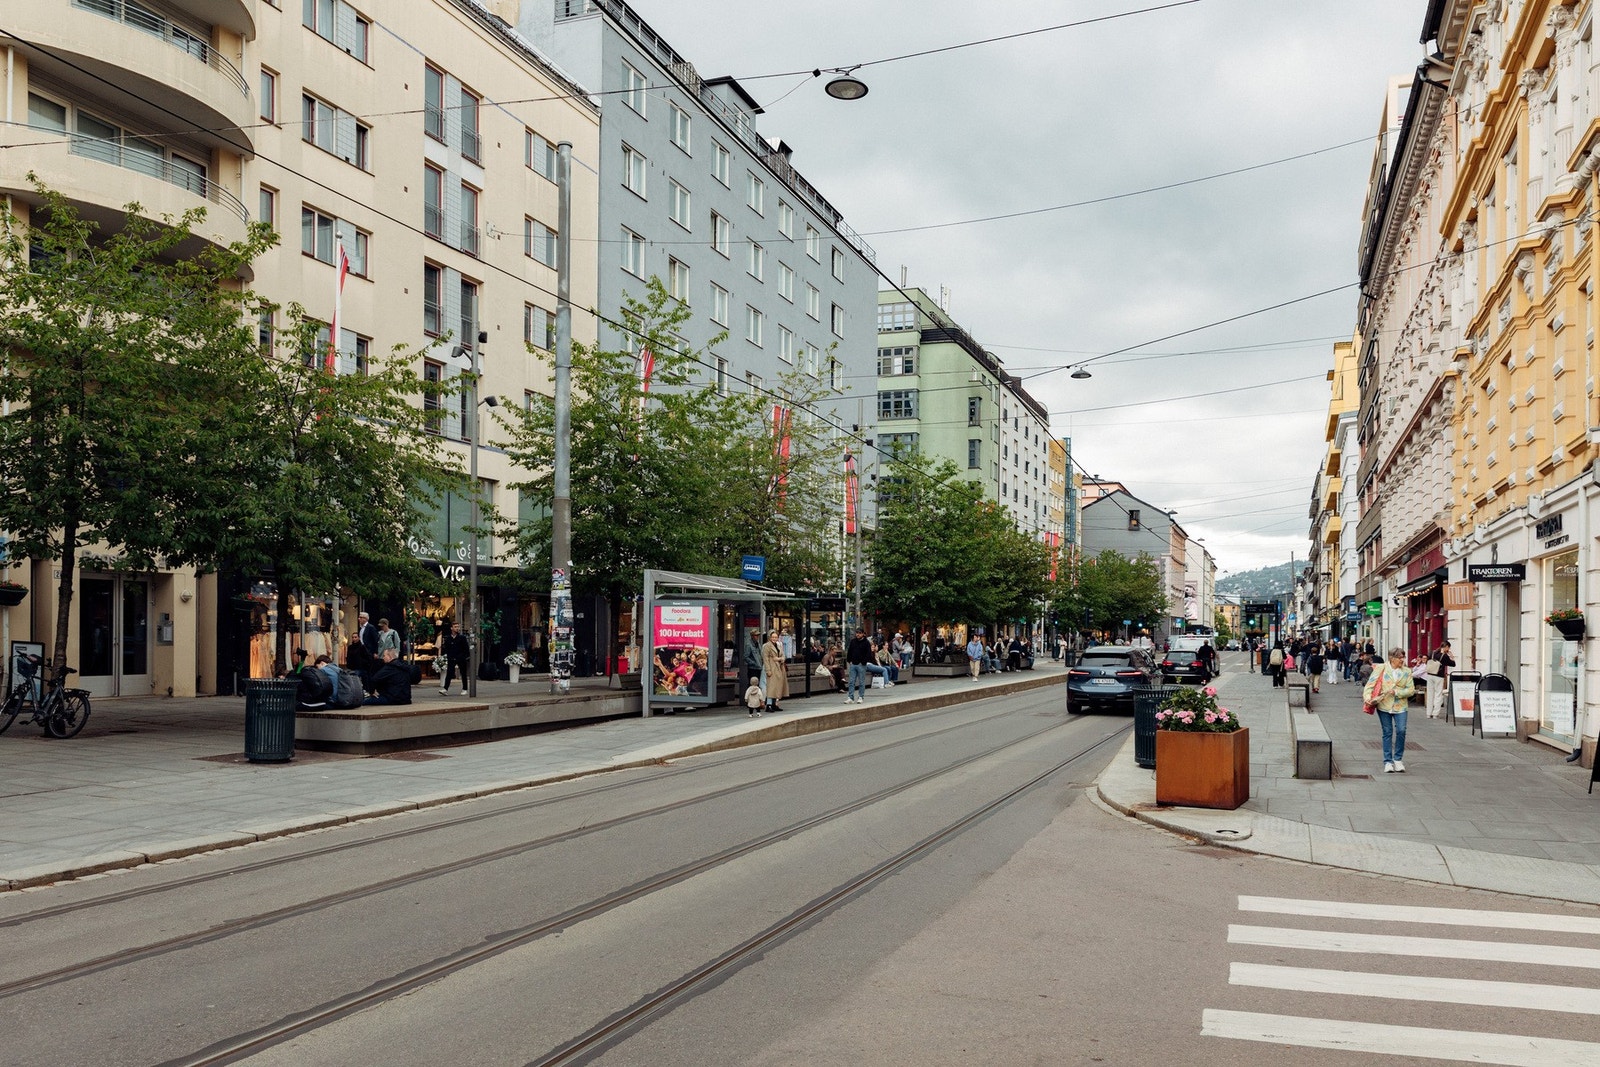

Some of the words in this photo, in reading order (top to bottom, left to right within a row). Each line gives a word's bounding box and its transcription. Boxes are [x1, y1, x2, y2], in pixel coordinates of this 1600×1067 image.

[659, 629, 672, 637] 100
[673, 629, 680, 637] kr
[682, 630, 704, 638] rabatt
